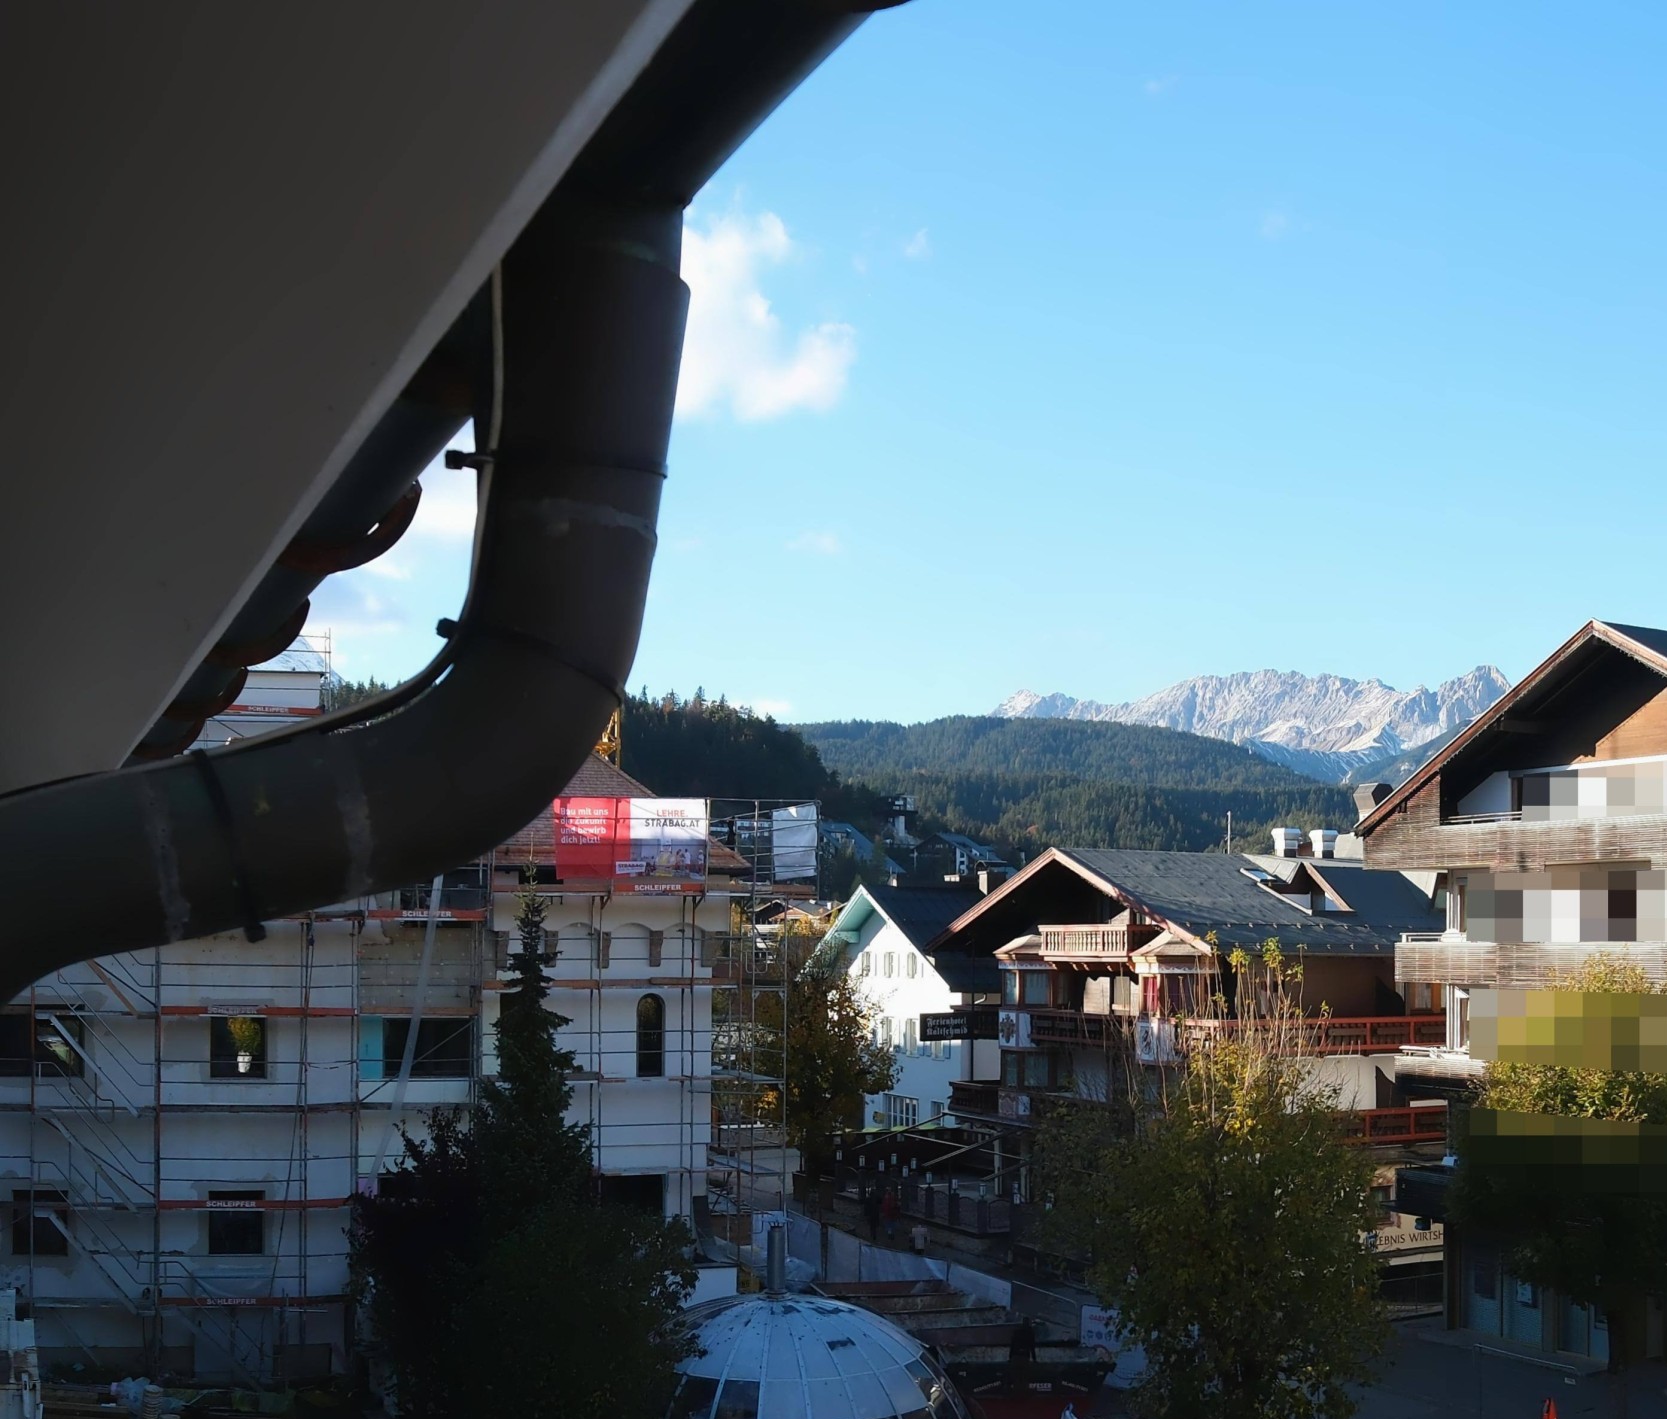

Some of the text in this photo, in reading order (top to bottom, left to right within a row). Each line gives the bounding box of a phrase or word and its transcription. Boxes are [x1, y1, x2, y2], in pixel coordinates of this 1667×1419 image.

[560, 808, 609, 816] Bau mit uns
[656, 809, 689, 818] LEHRE.
[644, 819, 700, 828] STRABAG.AT
[560, 836, 601, 845] dich jetzt!
[634, 884, 682, 892] SCHLEIPFER
[402, 910, 452, 918] SCHLEIFER
[207, 1007, 258, 1015] SCHLEIPFER
